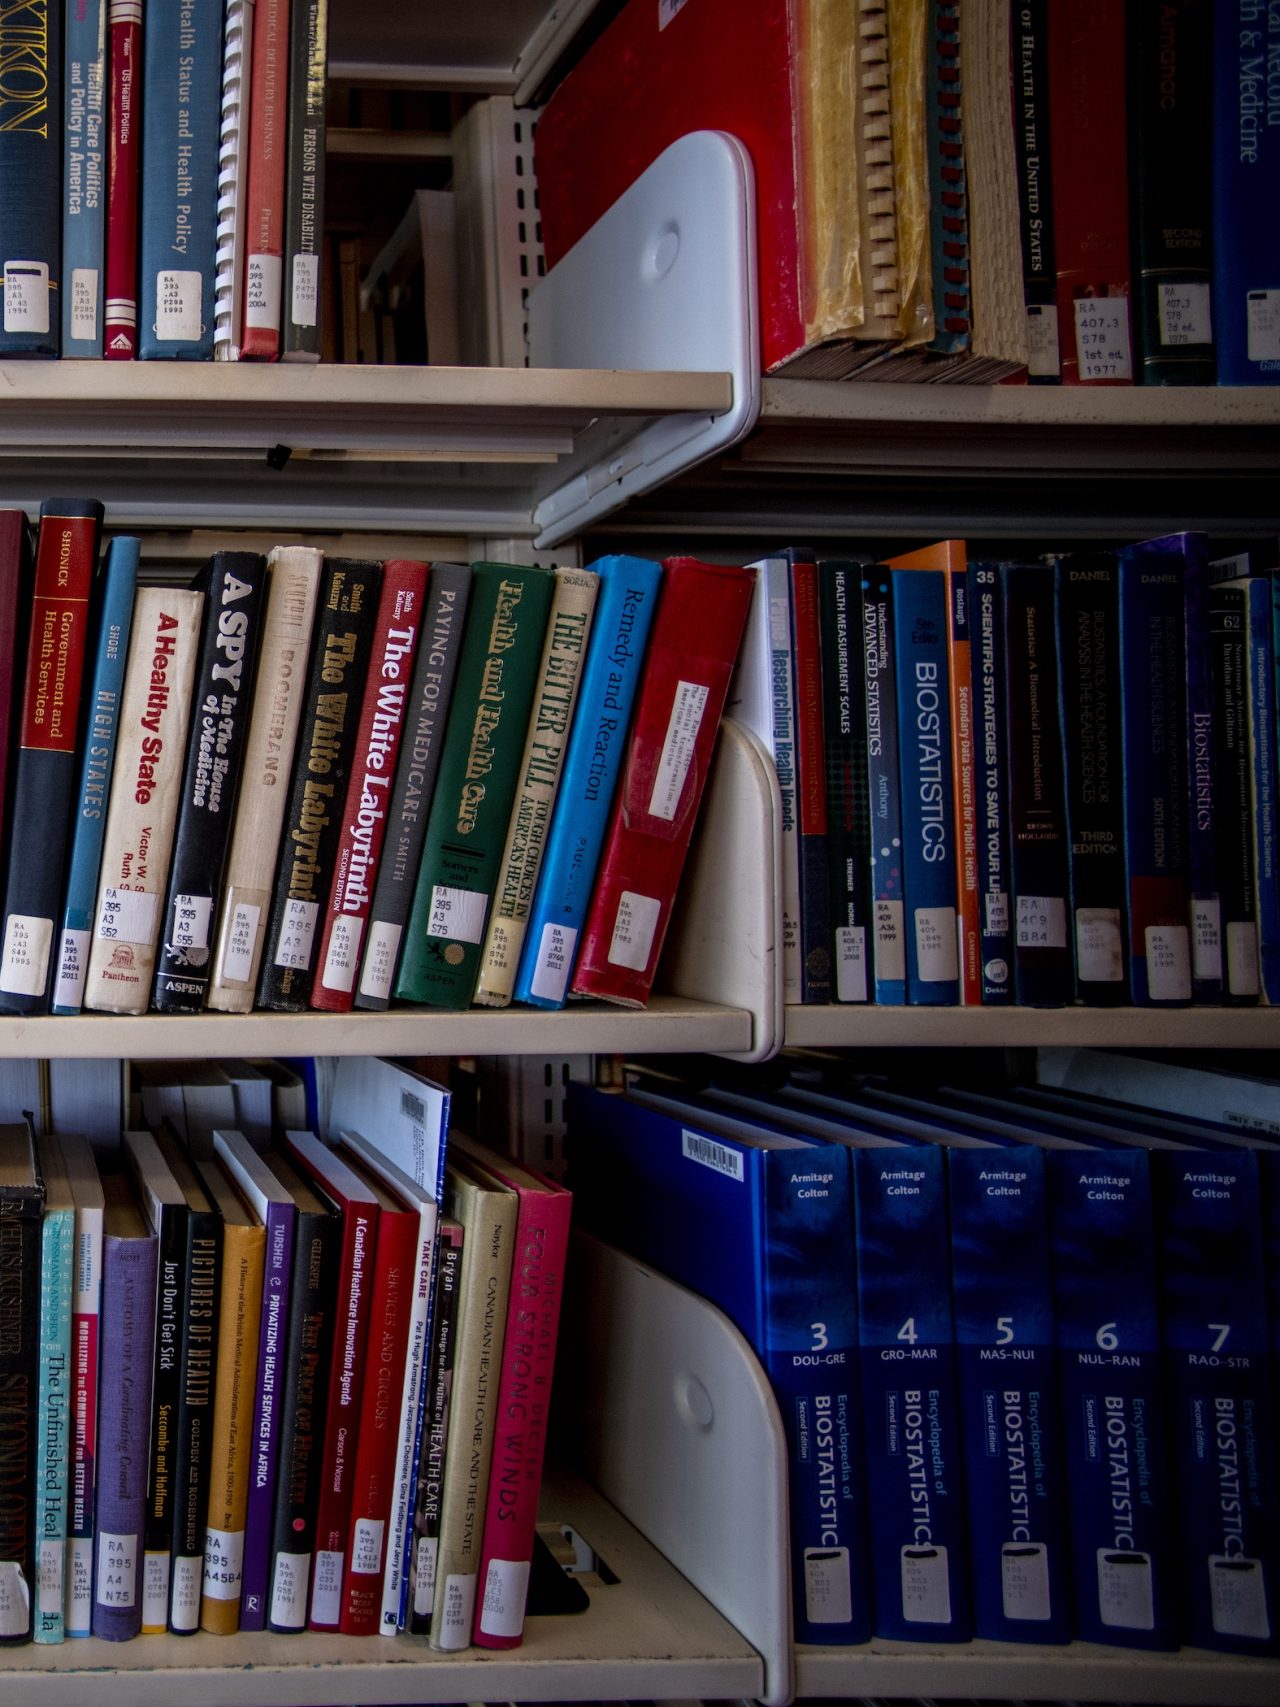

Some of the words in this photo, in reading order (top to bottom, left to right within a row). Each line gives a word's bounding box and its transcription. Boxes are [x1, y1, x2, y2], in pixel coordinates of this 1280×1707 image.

[1020, 10, 1031, 29] OF
[121, 70, 130, 80] US
[1022, 35, 1034, 96] HEALTH
[121, 84, 130, 110] Health
[1024, 104, 1035, 119] IN
[119, 113, 130, 144] Politics
[1025, 123, 1036, 151] THE
[1026, 157, 1039, 213] UNITED
[1029, 219, 1043, 271] STATES
[1080, 304, 1095, 313] RA
[1081, 319, 1119, 328] 407.3
[1082, 334, 1105, 344] S78
[1085, 351, 1103, 359] 1st
[1087, 365, 1116, 375] 1977
[222, 573, 252, 605] A
[159, 612, 179, 631] A
[955, 588, 966, 624] Boslaugh
[106, 625, 121, 659] SHORE
[428, 589, 456, 666] PAYING
[864, 602, 883, 677] ADVANCED
[876, 602, 888, 668] Understanding
[212, 612, 247, 691] SPY
[144, 635, 177, 732] Healthy
[421, 671, 442, 712] FOR
[91, 690, 116, 739] HIGH
[204, 695, 219, 713] of
[222, 696, 236, 713] In
[868, 681, 883, 756] STATISTICS
[958, 686, 970, 736] Secondary
[216, 718, 234, 753] The
[959, 740, 970, 762] Data
[134, 737, 161, 804] State
[192, 716, 216, 807] Medicine
[402, 717, 434, 822] MEDICARE
[915, 662, 945, 863] BIOSTATISTICS
[82, 746, 108, 820] STAKES
[208, 758, 229, 812] House
[878, 774, 890, 819] Anthony
[960, 765, 972, 803] Sources
[962, 806, 973, 820] for
[962, 823, 974, 854] Public
[393, 837, 409, 881] SMITH
[964, 857, 976, 890] Health
[105, 903, 121, 912] 395
[106, 889, 117, 898] RA
[101, 927, 116, 937] S52
[102, 915, 114, 924] A3
[790, 1172, 833, 1184] Armitage
[880, 1170, 925, 1182] Armitage
[887, 1185, 920, 1196] Colton
[798, 1188, 829, 1198] Colton
[271, 1224, 285, 1268] TURSHEN
[161, 1260, 178, 1284] Just
[160, 1323, 175, 1343] Get
[264, 1294, 280, 1353] PRIVATIZING
[810, 1323, 829, 1350] 3
[897, 1318, 918, 1344] 4
[159, 1347, 175, 1370] Sick
[262, 1356, 276, 1392] HEALTH
[259, 1394, 274, 1438] SERVICES
[259, 1441, 271, 1451] IN
[256, 1454, 270, 1488] AFRICA
